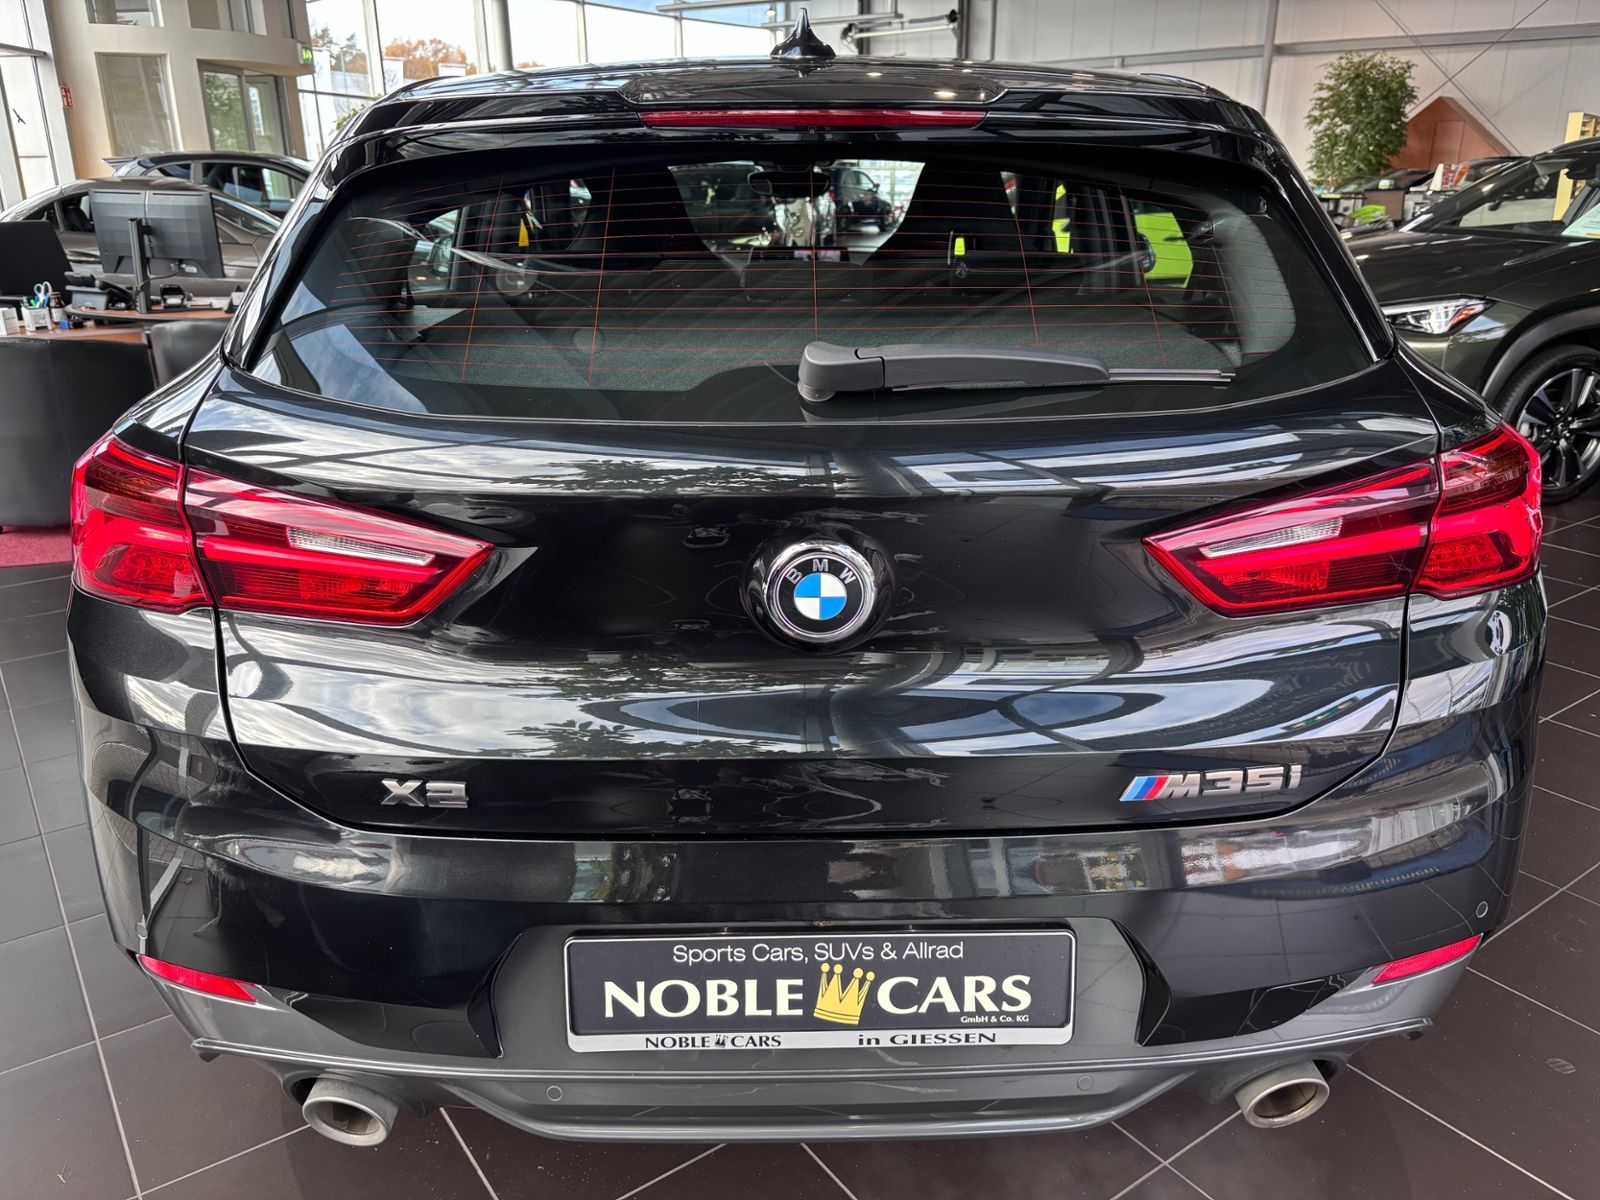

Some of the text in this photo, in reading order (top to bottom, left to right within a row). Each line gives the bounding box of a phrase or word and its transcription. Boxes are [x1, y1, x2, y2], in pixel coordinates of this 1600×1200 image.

[785, 558, 857, 585] BMW
[380, 778, 469, 808] X2
[1155, 764, 1302, 800] M35i
[672, 941, 964, 966] Sports Cars, SUVs & Allrad
[604, 974, 1032, 1018] NOBLE CARS
[960, 1015, 989, 1024] GmbH
[990, 1015, 998, 1023] &
[1016, 1014, 1030, 1022] KG
[645, 1035, 782, 1049] NOBLE CARS
[858, 1032, 996, 1046] in GIESSEN
